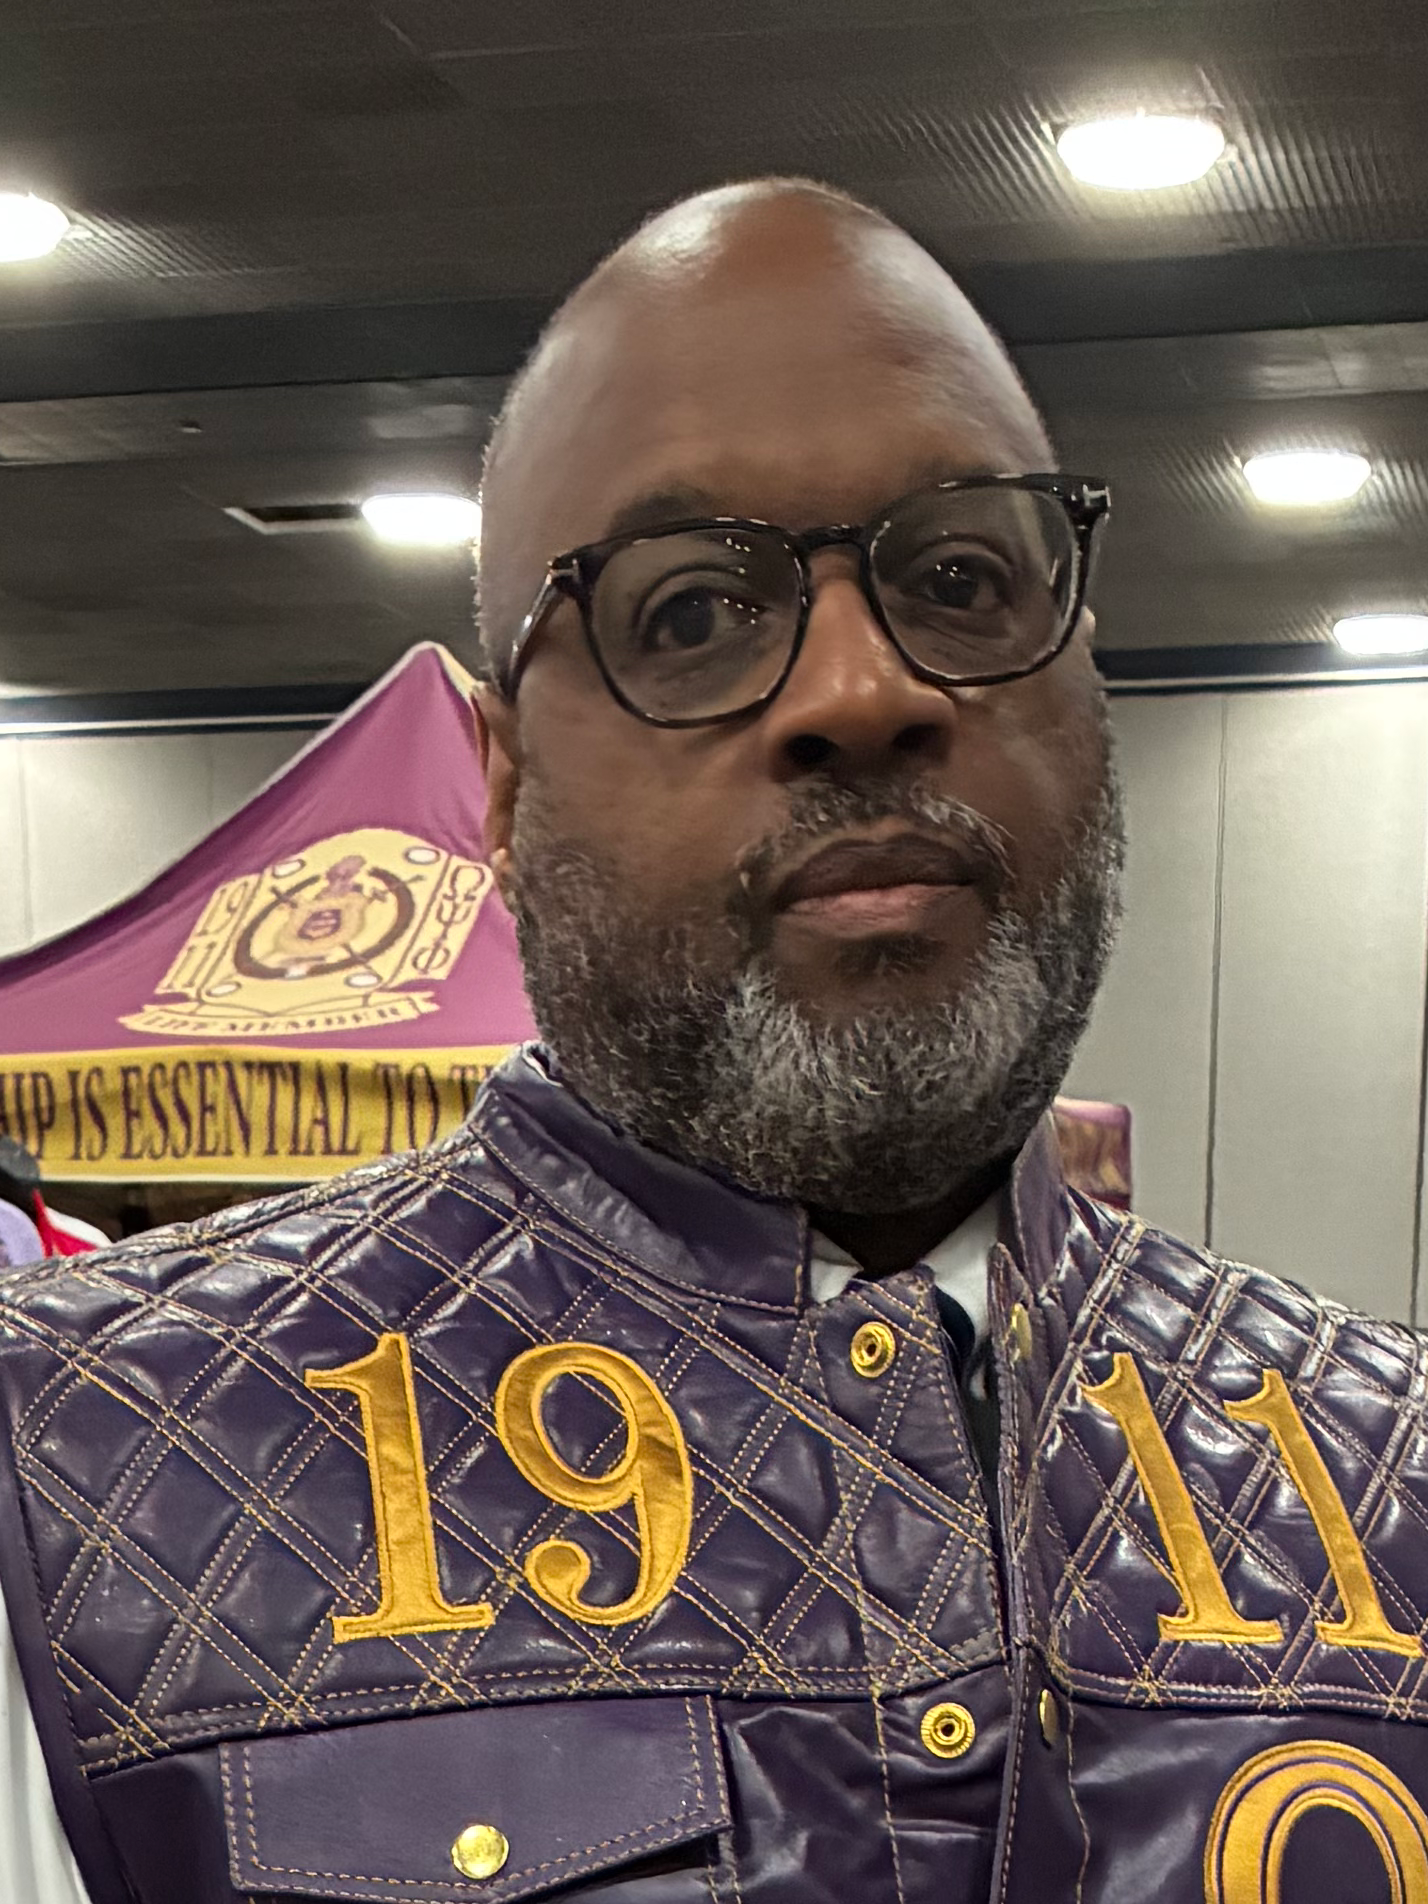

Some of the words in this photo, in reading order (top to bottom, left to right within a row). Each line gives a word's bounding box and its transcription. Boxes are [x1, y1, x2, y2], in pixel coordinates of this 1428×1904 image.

[197, 880, 251, 937] 19
[166, 941, 217, 991] 11
[67, 1066, 108, 1161] IS
[121, 1060, 361, 1160] ESSENTIAL
[374, 1062, 439, 1155] TO
[304, 1330, 693, 1644] 19
[1081, 1352, 1423, 1658] 11
